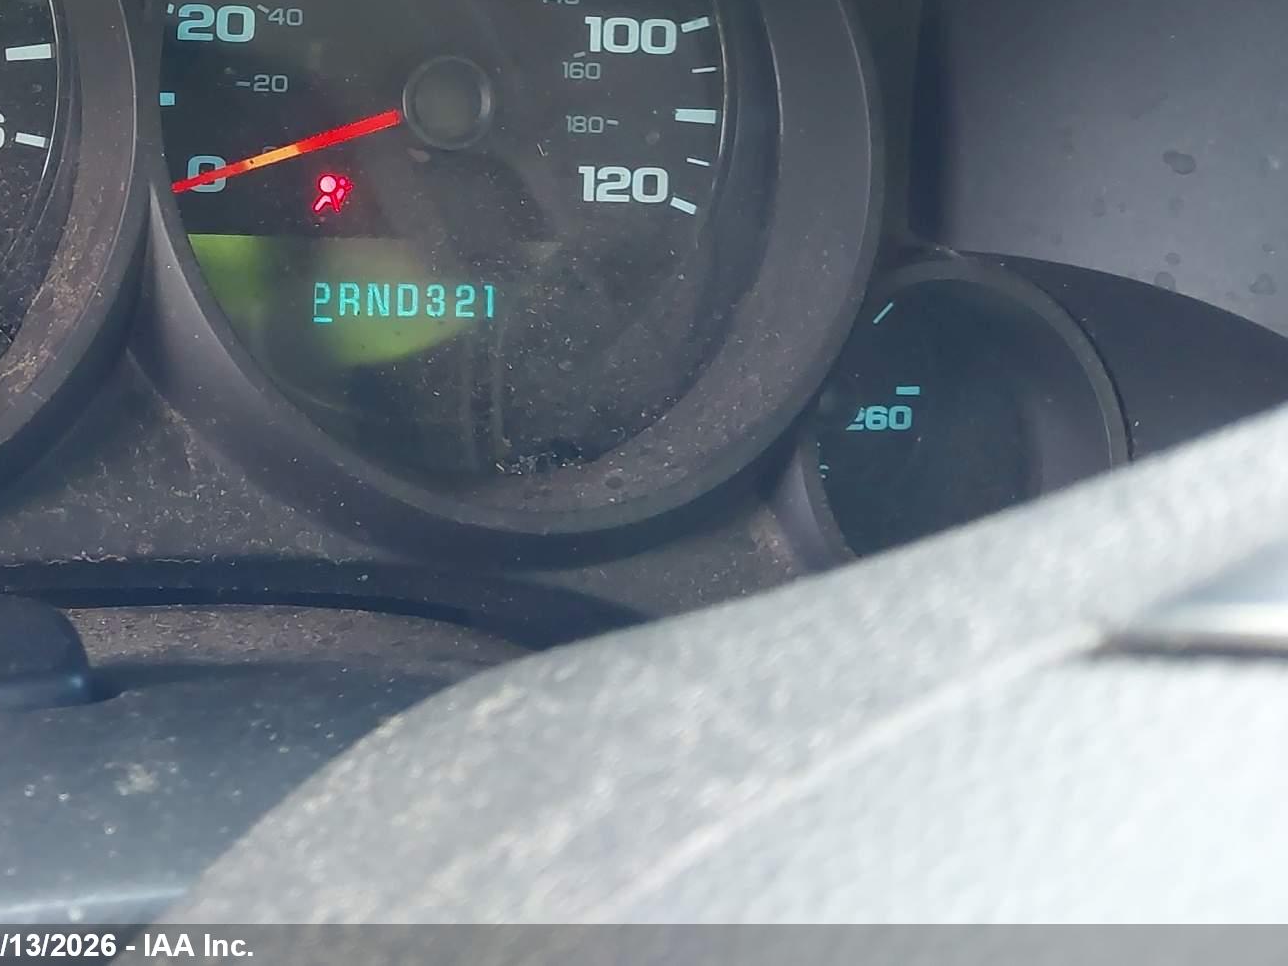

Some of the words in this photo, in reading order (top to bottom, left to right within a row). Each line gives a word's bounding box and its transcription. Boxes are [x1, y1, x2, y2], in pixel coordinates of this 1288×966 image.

[177, 4, 255, 42] 20
[268, 8, 303, 26] 40
[585, 16, 677, 54] 100
[253, 75, 288, 93] 20
[562, 62, 601, 80] 160
[566, 115, 604, 133] 180
[187, 155, 226, 193] 0
[579, 166, 668, 203] 120
